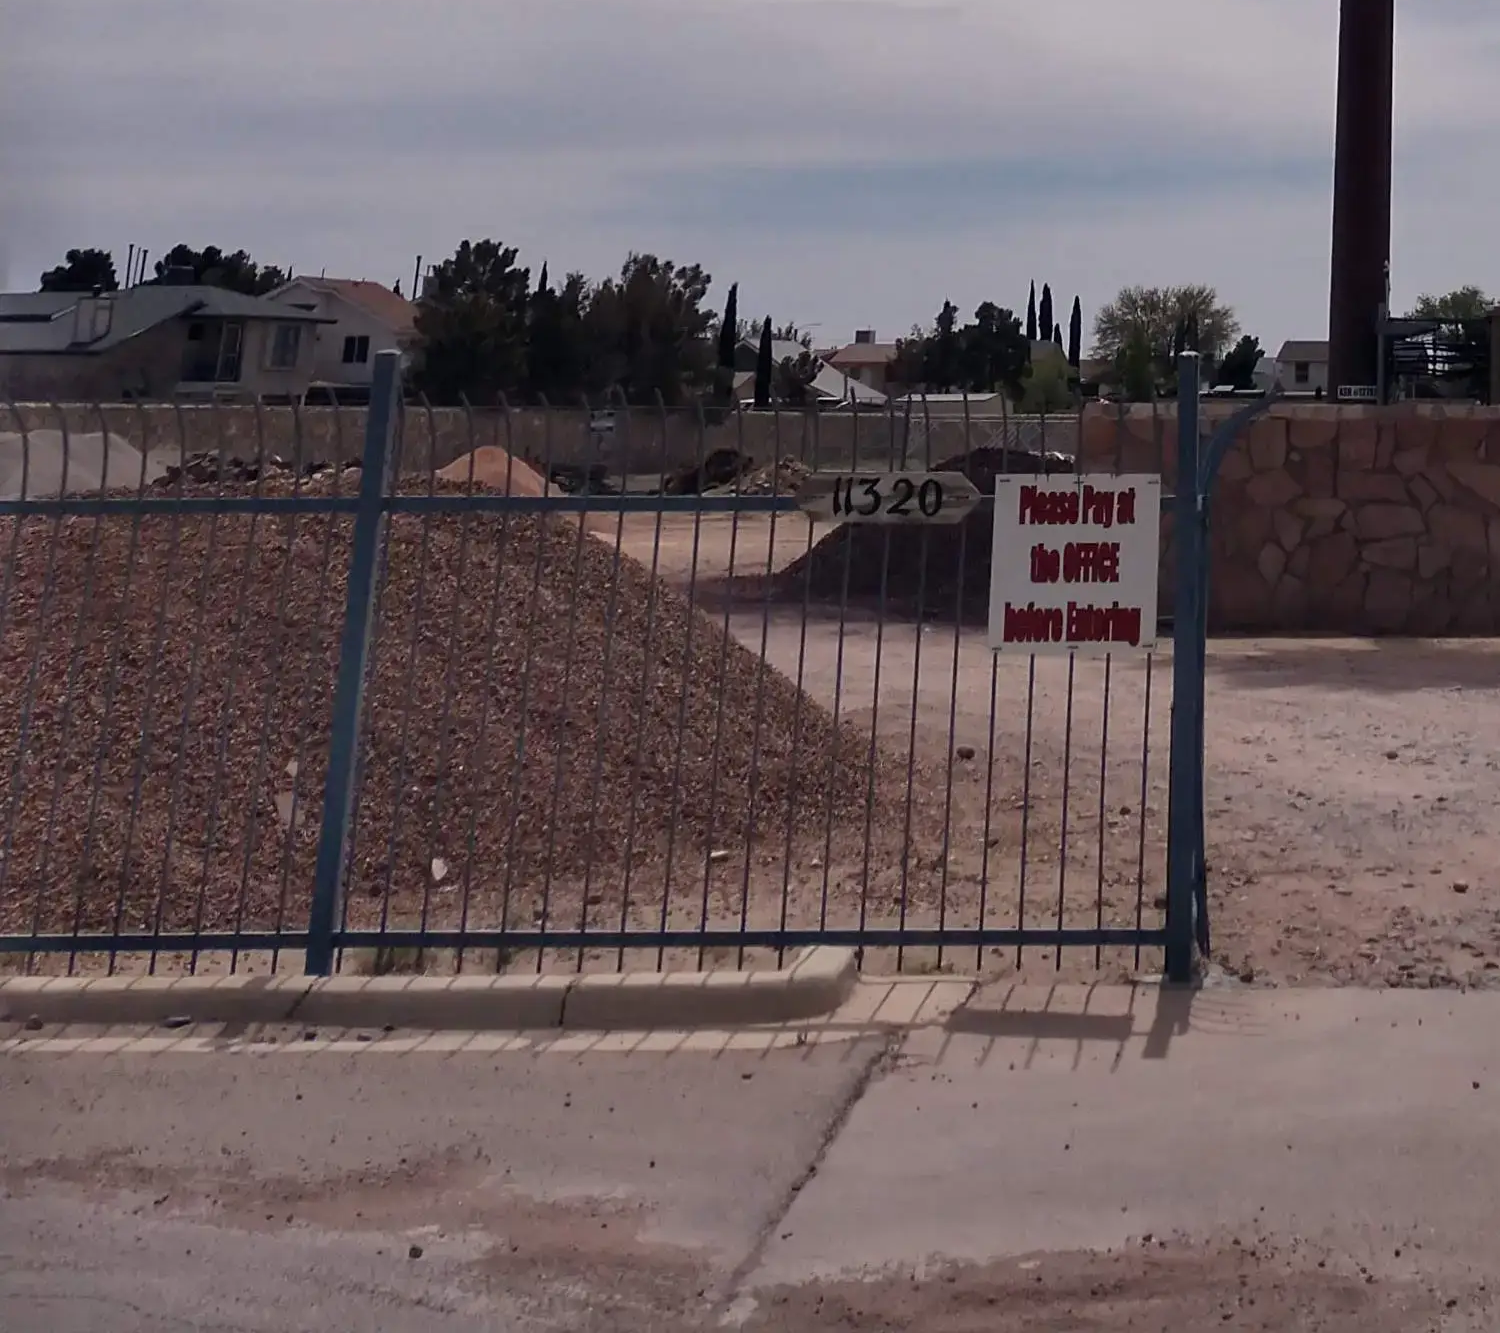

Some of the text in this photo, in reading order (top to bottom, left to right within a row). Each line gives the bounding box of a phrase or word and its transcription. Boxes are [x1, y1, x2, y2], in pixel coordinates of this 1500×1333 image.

[833, 476, 943, 517] 11320
[1019, 484, 1136, 529] Please Pay at
[1030, 542, 1121, 583] the OFFICE
[1003, 601, 1142, 647] before Entering
